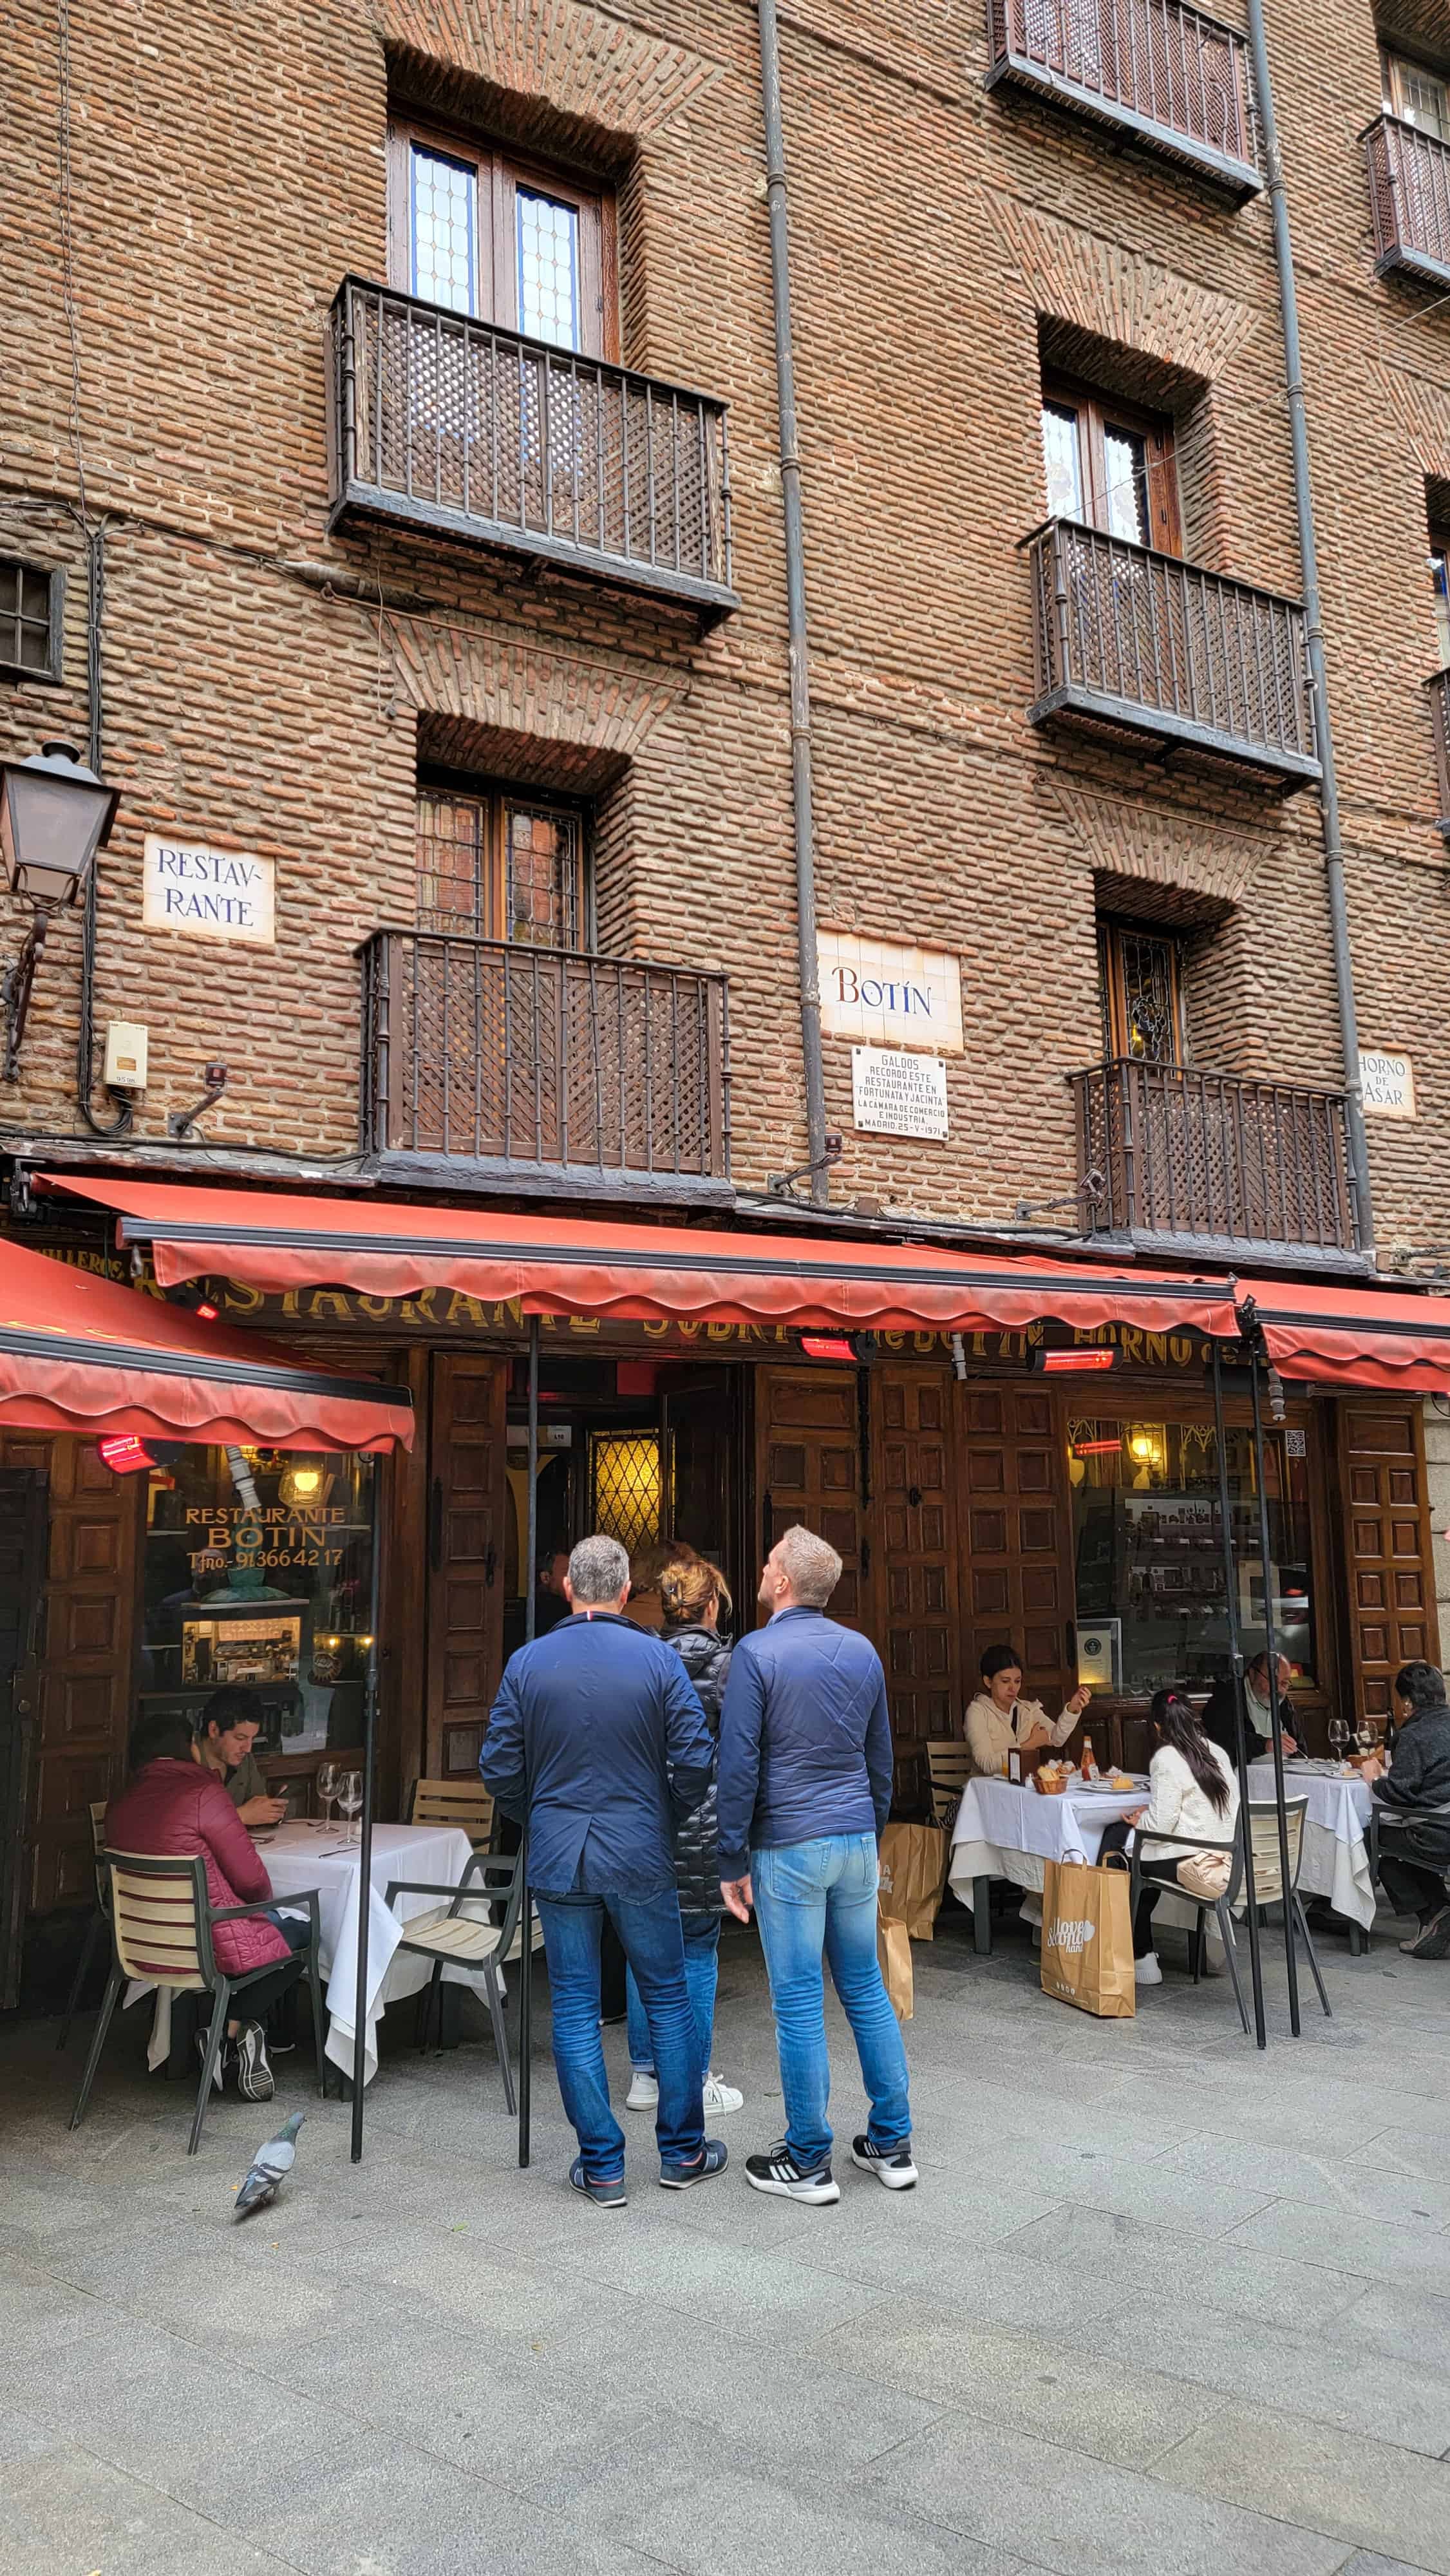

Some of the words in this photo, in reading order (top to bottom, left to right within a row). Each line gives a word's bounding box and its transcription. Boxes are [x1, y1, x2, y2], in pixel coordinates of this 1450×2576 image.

[164, 887, 254, 927] RANTE
[832, 966, 932, 1018] BOTÍN
[881, 1054, 919, 1070] GALDOS
[865, 1076, 923, 1093] RESTAURANTE
[926, 1084, 936, 1095] EN
[910, 1072, 932, 1083] ESTE
[1375, 1076, 1389, 1086] DE
[905, 1092, 909, 1102] Y
[1364, 1082, 1405, 1108] ASAR
[899, 1104, 909, 1113] DE
[910, 1106, 945, 1118] COMERCIO
[185, 1508, 345, 1524] RESTAURANTE
[207, 1527, 326, 1549] BOTIN
